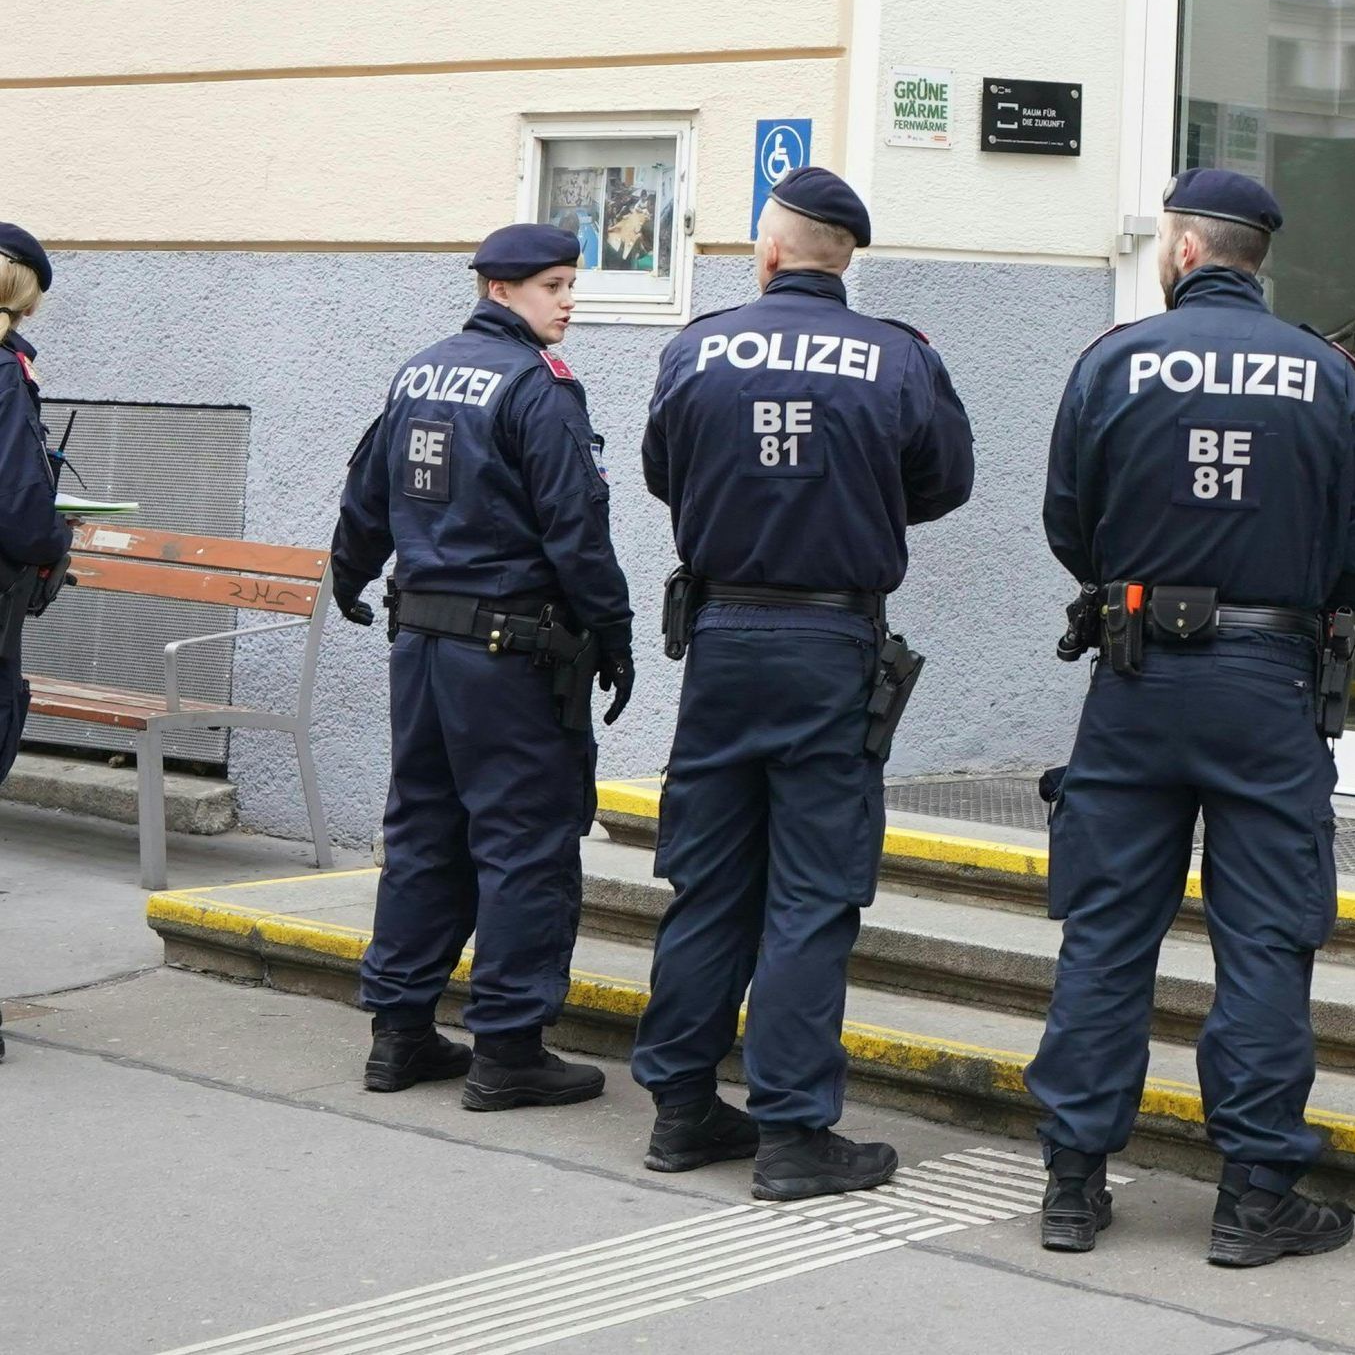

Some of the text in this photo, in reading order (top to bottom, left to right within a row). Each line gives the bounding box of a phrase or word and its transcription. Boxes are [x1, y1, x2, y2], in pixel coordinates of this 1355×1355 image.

[894, 78, 948, 102] GRÜNE
[894, 100, 948, 120] WÄRME
[894, 119, 947, 133] FERNWÄRME
[1022, 108, 1056, 117] RAUM FÜR
[1022, 118, 1065, 128] DIE ZUKUNFT
[696, 332, 881, 382] POLIZEI
[393, 364, 502, 407] POLIZEI
[1129, 350, 1317, 403] POLIZEI
[753, 401, 813, 433] BE
[408, 428, 446, 465] BE
[759, 435, 798, 467] 81
[1188, 428, 1252, 465] BE
[414, 468, 432, 490] 81
[1192, 466, 1243, 501] 81
